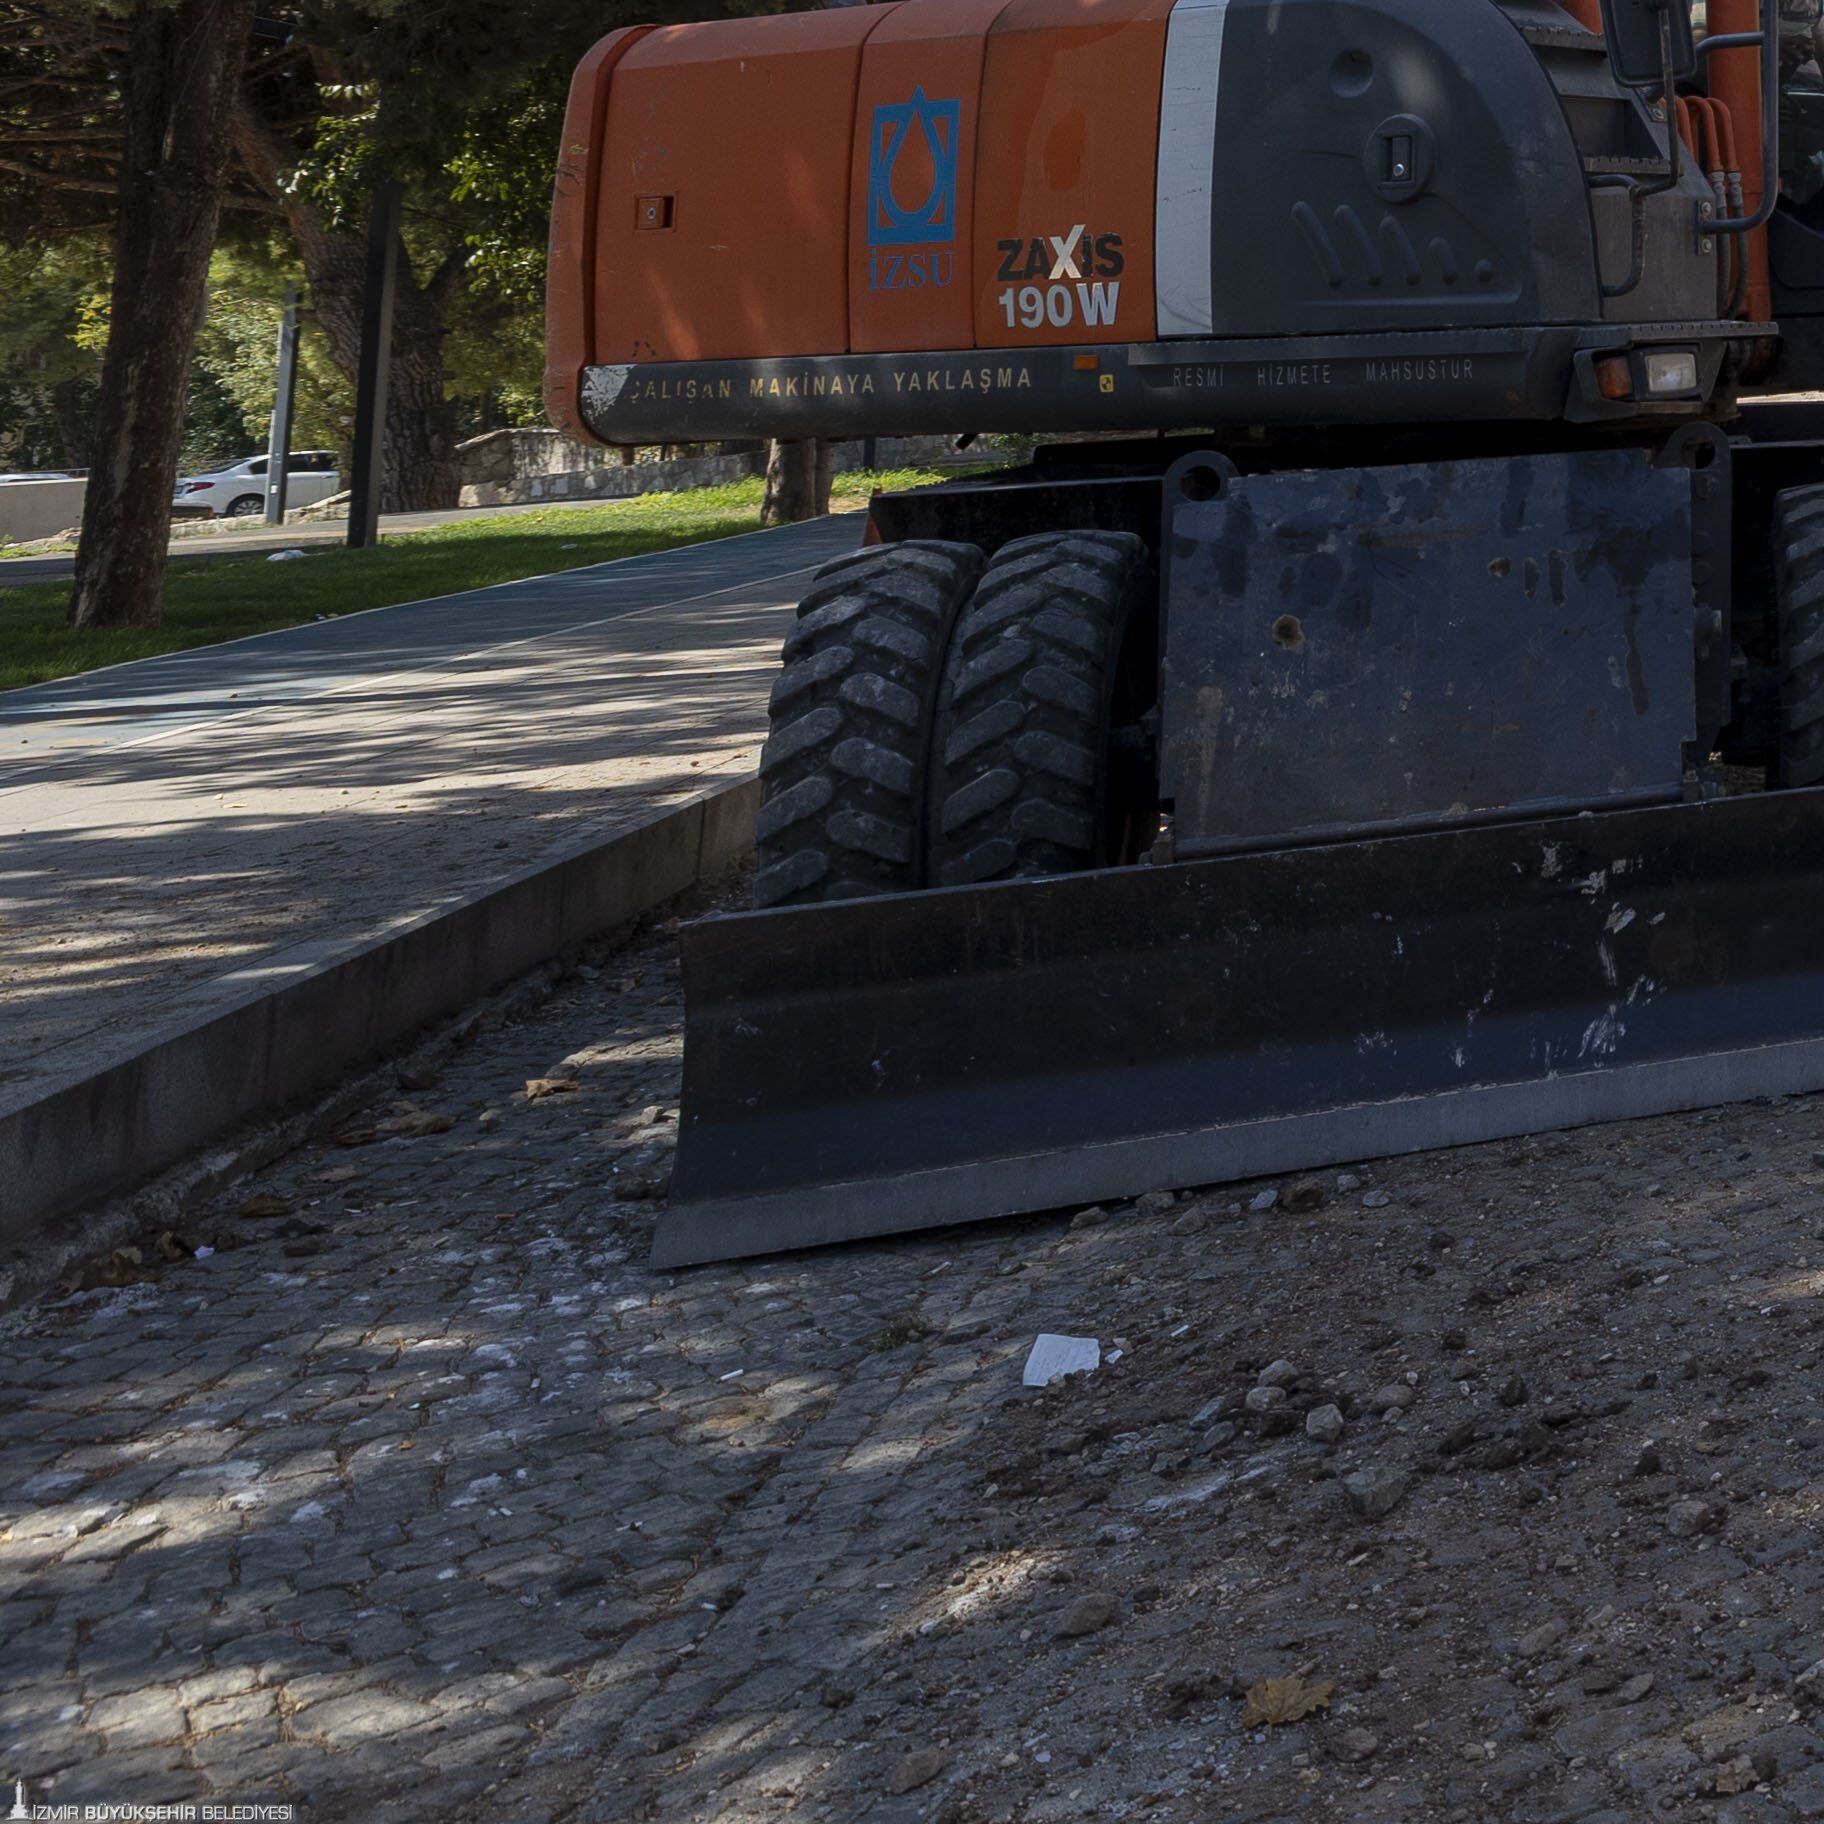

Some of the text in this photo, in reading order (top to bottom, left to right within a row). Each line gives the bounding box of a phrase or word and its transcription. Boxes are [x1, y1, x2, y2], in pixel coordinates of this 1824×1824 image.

[997, 224, 1125, 281] ZAXIS
[750, 371, 874, 397] MAKİNAYA
[894, 367, 1031, 394] YAKLAŞMA
[1173, 359, 1473, 387] RESMİ HİZMETE MAHSUSTUR
